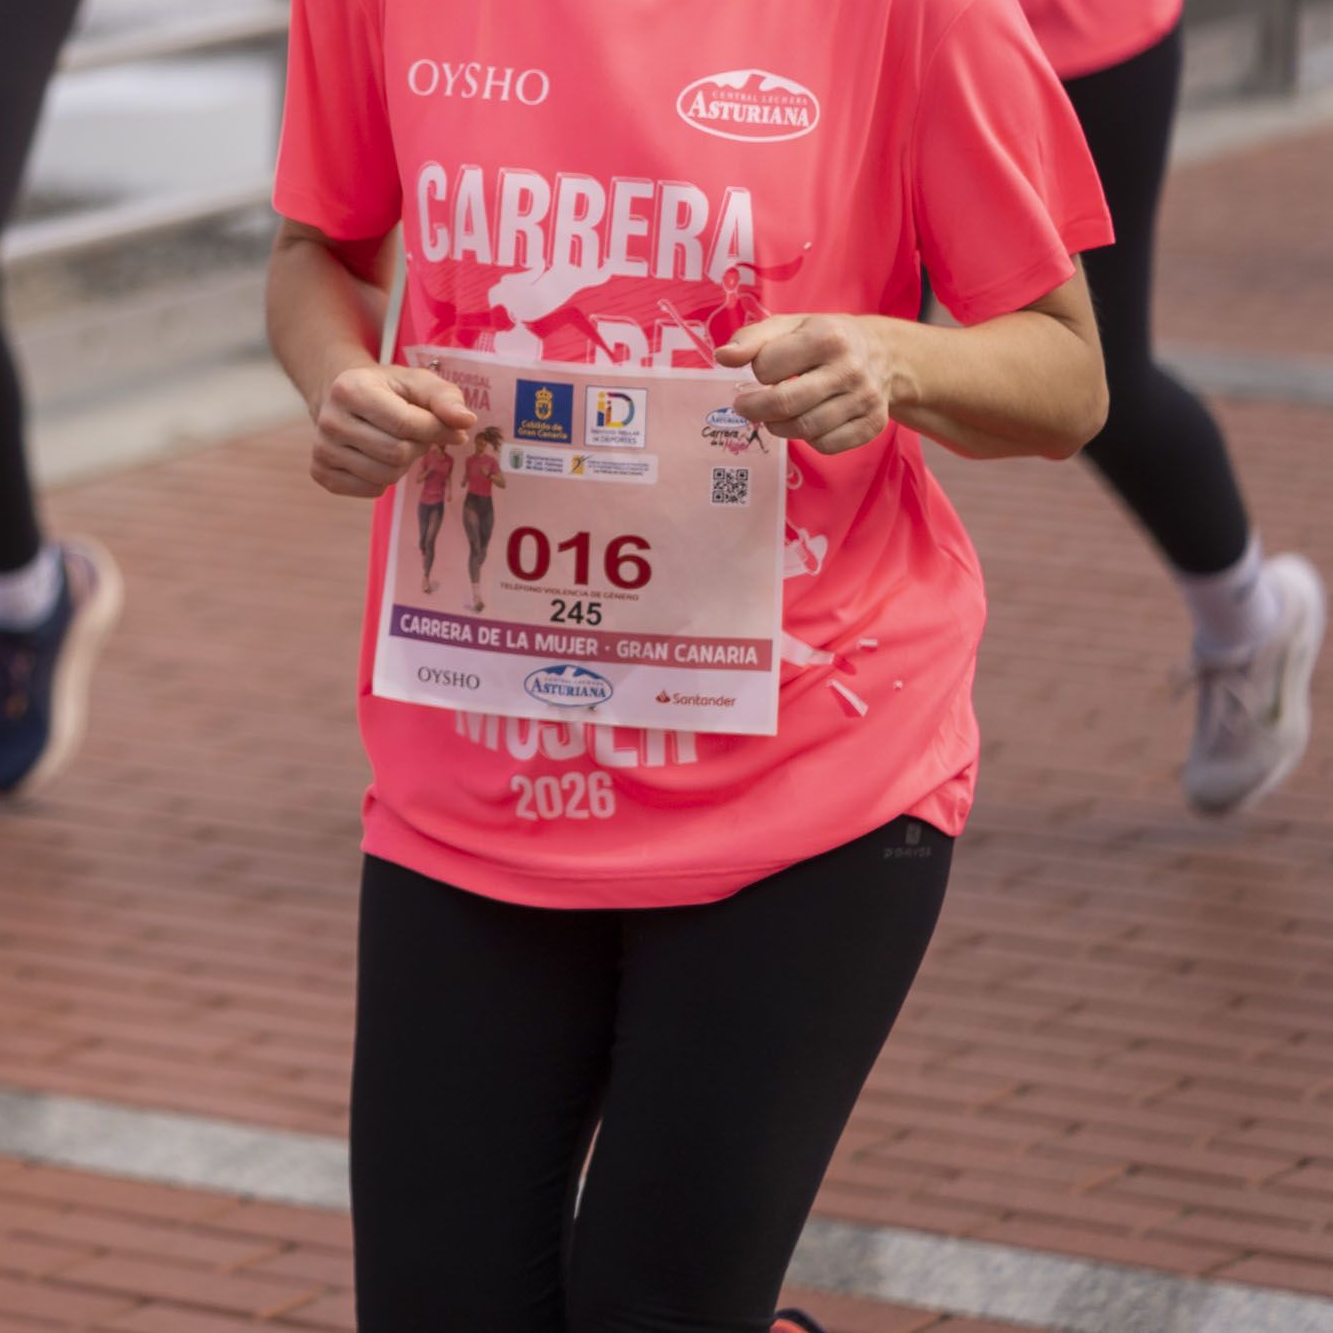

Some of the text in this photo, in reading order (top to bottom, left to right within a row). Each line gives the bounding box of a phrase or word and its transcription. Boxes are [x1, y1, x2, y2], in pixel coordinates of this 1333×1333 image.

[407, 58, 550, 106] OYSHO
[687, 90, 809, 127] ASTURIANA
[414, 160, 757, 286] CARRERA
[464, 386, 491, 411] MA
[518, 427, 568, 440] Gran Canaria
[521, 419, 550, 430] Cabildo
[701, 426, 738, 438] Carrera
[506, 526, 652, 591] 016
[544, 586, 588, 597] VIOLENCIA
[603, 590, 639, 601] GÉNERO
[549, 598, 602, 626] 245
[400, 614, 758, 665] CARRERA DE LA MUJER GRAN CANARIA
[417, 666, 481, 690] OYSHO
[532, 677, 606, 698] ASTURIANA
[672, 692, 736, 707] Santander
[510, 770, 615, 822] 2026
